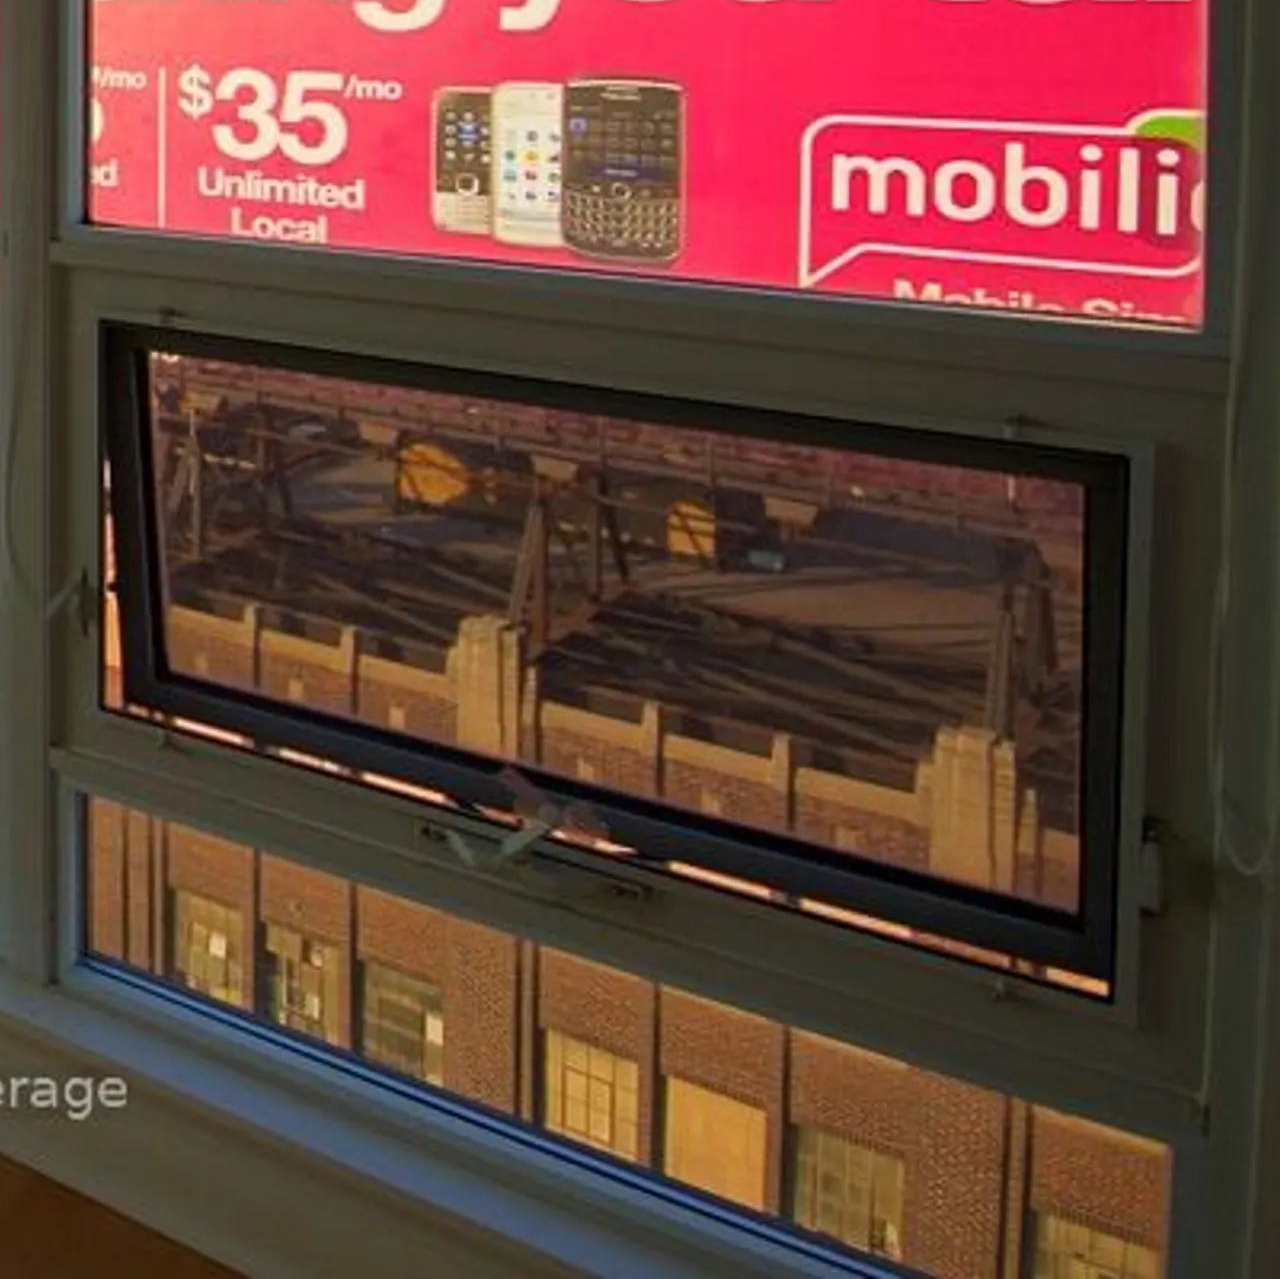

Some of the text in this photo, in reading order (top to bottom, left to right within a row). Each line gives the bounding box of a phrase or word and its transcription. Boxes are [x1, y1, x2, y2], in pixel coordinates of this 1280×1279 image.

[197, 166, 366, 211] Unlimited
[831, 142, 1206, 236] mobili
[230, 206, 329, 244] Local
